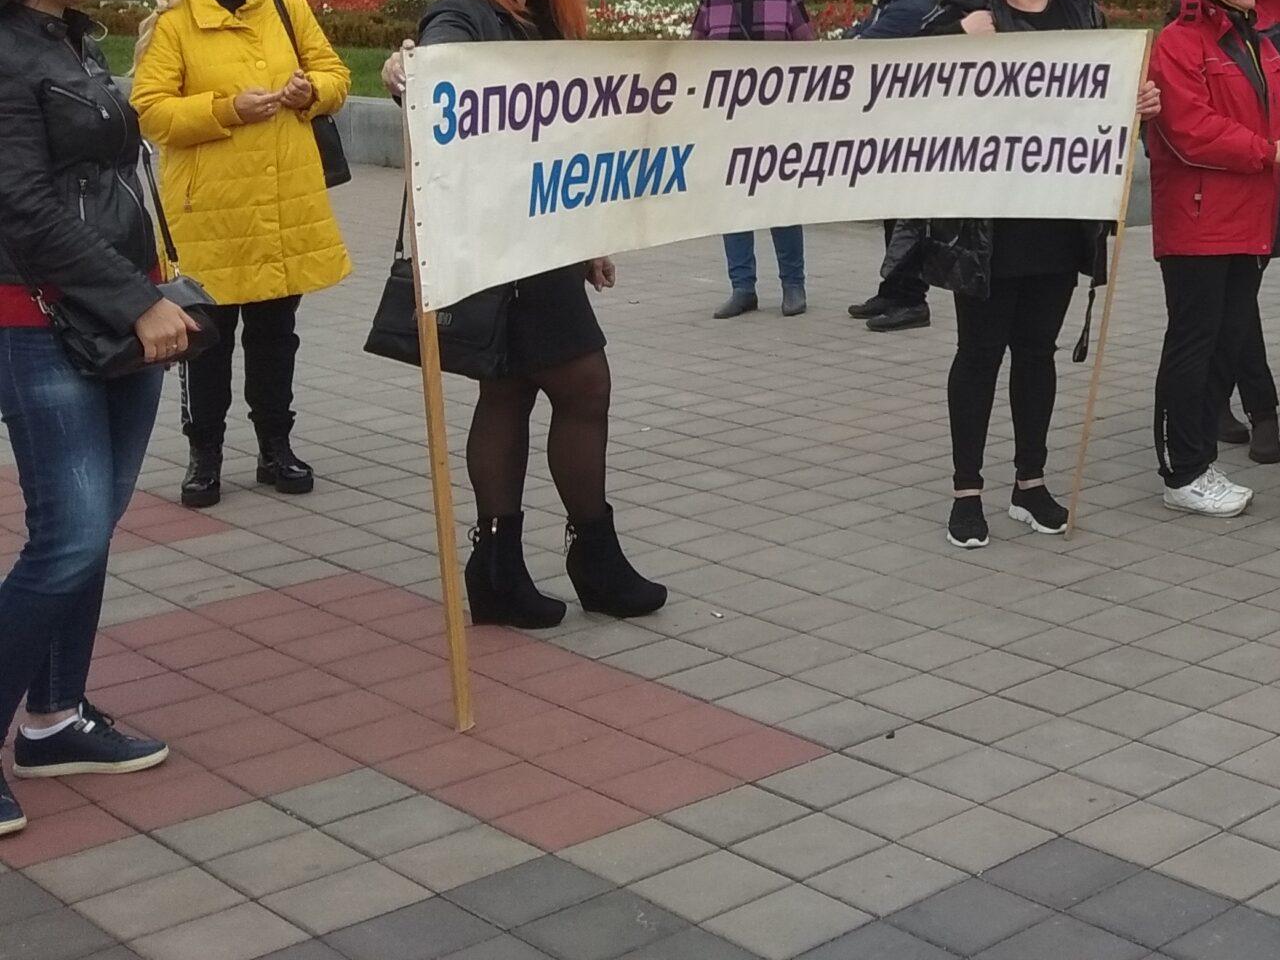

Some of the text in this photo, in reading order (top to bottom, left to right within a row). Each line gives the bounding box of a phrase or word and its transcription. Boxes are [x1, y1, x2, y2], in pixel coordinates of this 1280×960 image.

[433, 72, 677, 145] Запорожье
[703, 64, 855, 120] против
[863, 60, 1110, 112] уничтожения
[529, 126, 1128, 218] мелких предпринимателей!
